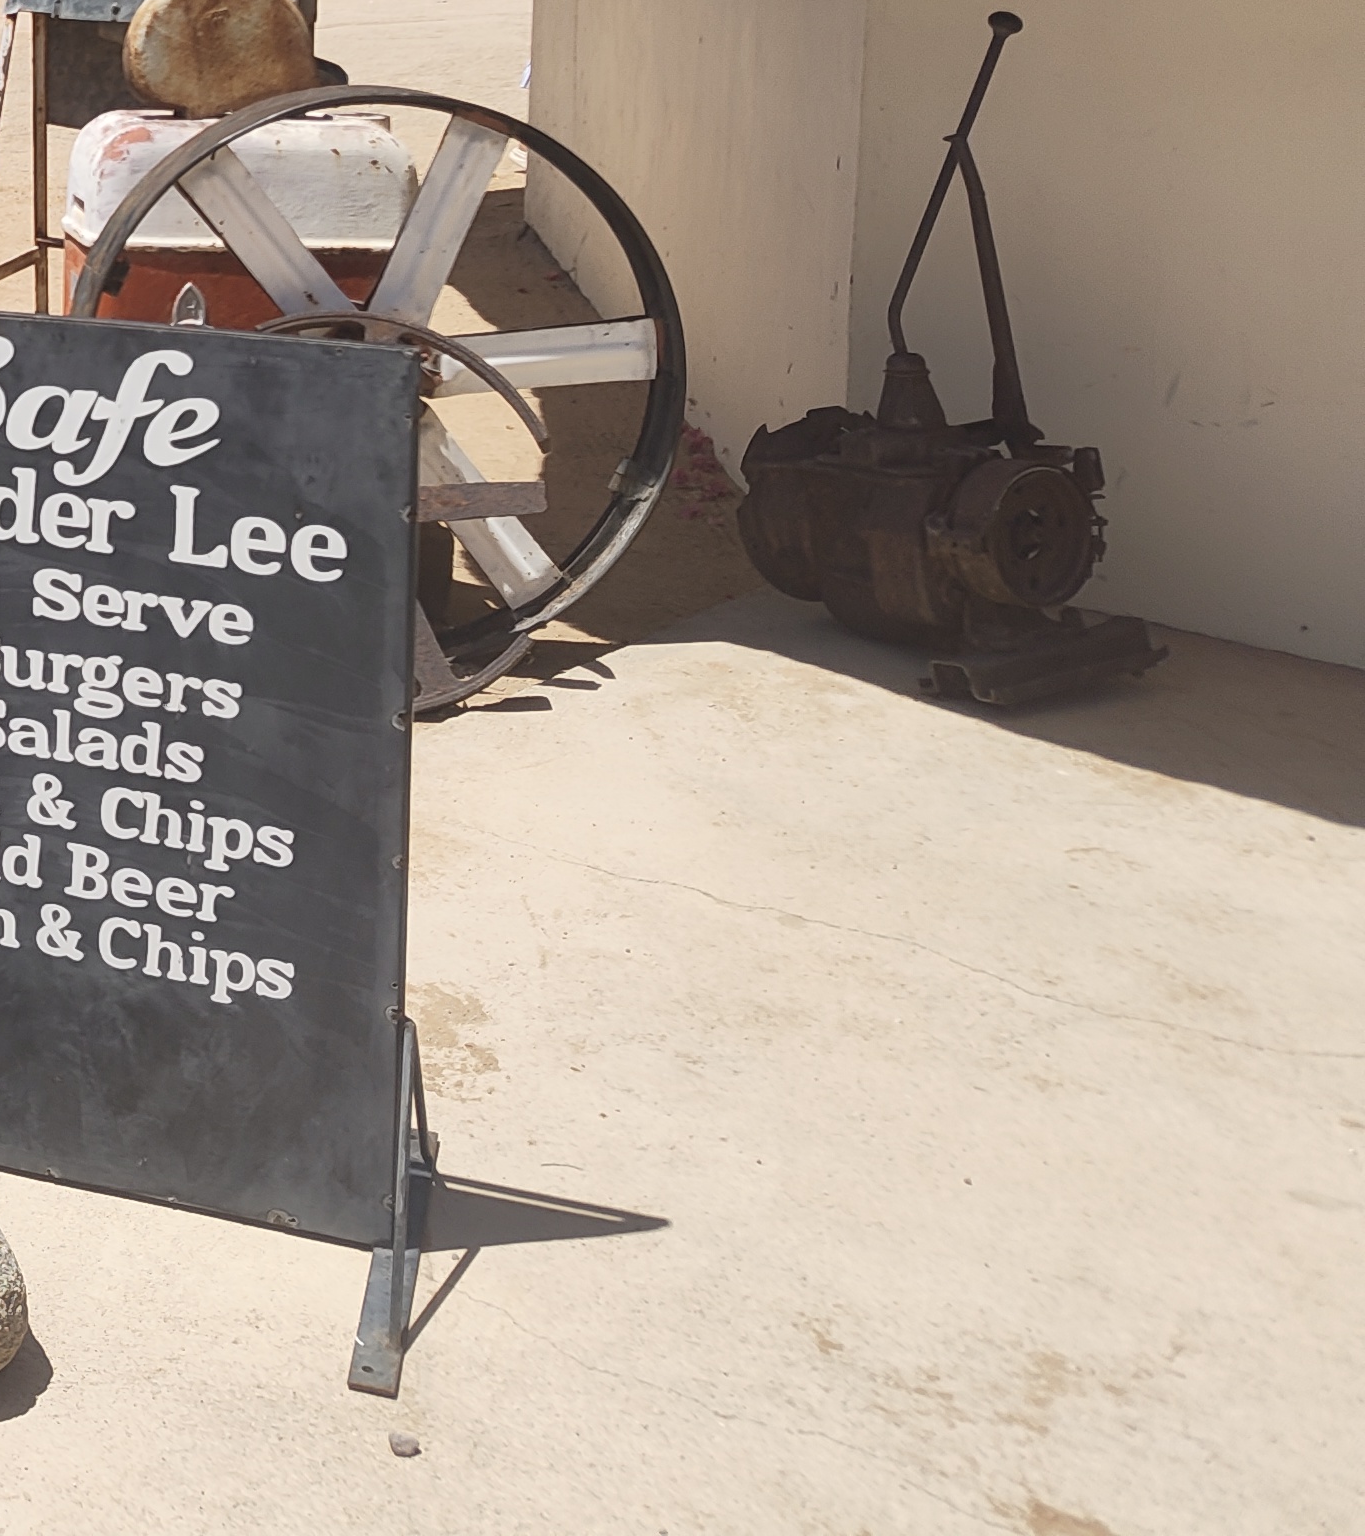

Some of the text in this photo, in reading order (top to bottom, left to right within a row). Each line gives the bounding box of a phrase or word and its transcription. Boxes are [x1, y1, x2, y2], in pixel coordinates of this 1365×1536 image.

[168, 484, 349, 584] Lee
[32, 568, 254, 646] Serve
[26, 772, 77, 831] &
[99, 786, 295, 873] Chips
[63, 841, 236, 924] Beer
[35, 903, 85, 962] &
[98, 916, 296, 1005] Chips
